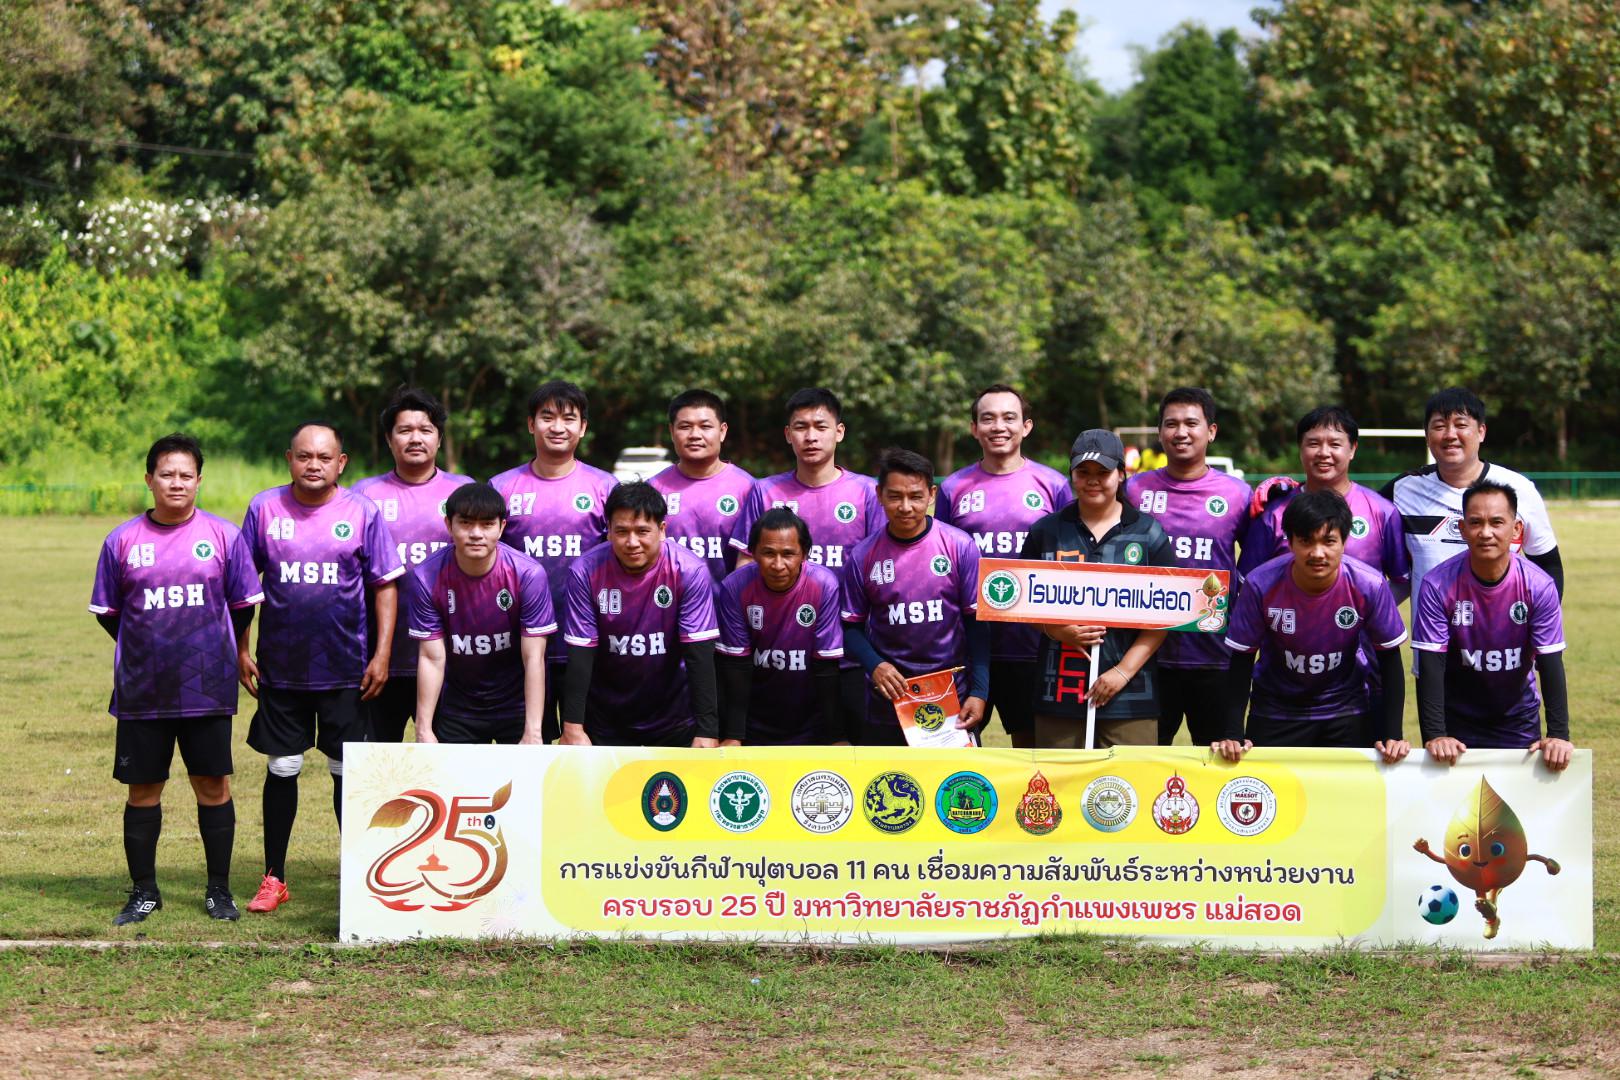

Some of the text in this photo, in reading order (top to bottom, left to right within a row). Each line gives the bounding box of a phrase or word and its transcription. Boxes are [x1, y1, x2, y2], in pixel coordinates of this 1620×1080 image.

[523, 534, 582, 558] MSH
[808, 545, 843, 567] SH
[1166, 536, 1214, 561] SH
[280, 561, 339, 585] MSH
[143, 583, 205, 610] MSH
[1028, 574, 1191, 612] โรงพยาบาลแม่สอด
[888, 599, 944, 626] MSH
[452, 631, 512, 656] MSH
[608, 631, 666, 657] MSH
[752, 648, 807, 671] MSH
[1284, 650, 1342, 675] MSH
[1461, 647, 1522, 672] MSH
[467, 815, 482, 827] th
[366, 788, 510, 900] 25
[559, 849, 1355, 888] การแข่งขันกีฬาฟุตบอล 11 คน เชื่อมความสัมพันธ์ระหว่างหน่วยงาน
[603, 891, 1301, 926] ครบรอบ 25 ปี มหาวิทยาลัยราชภัฏกำแพงเพชร แม่สอด
